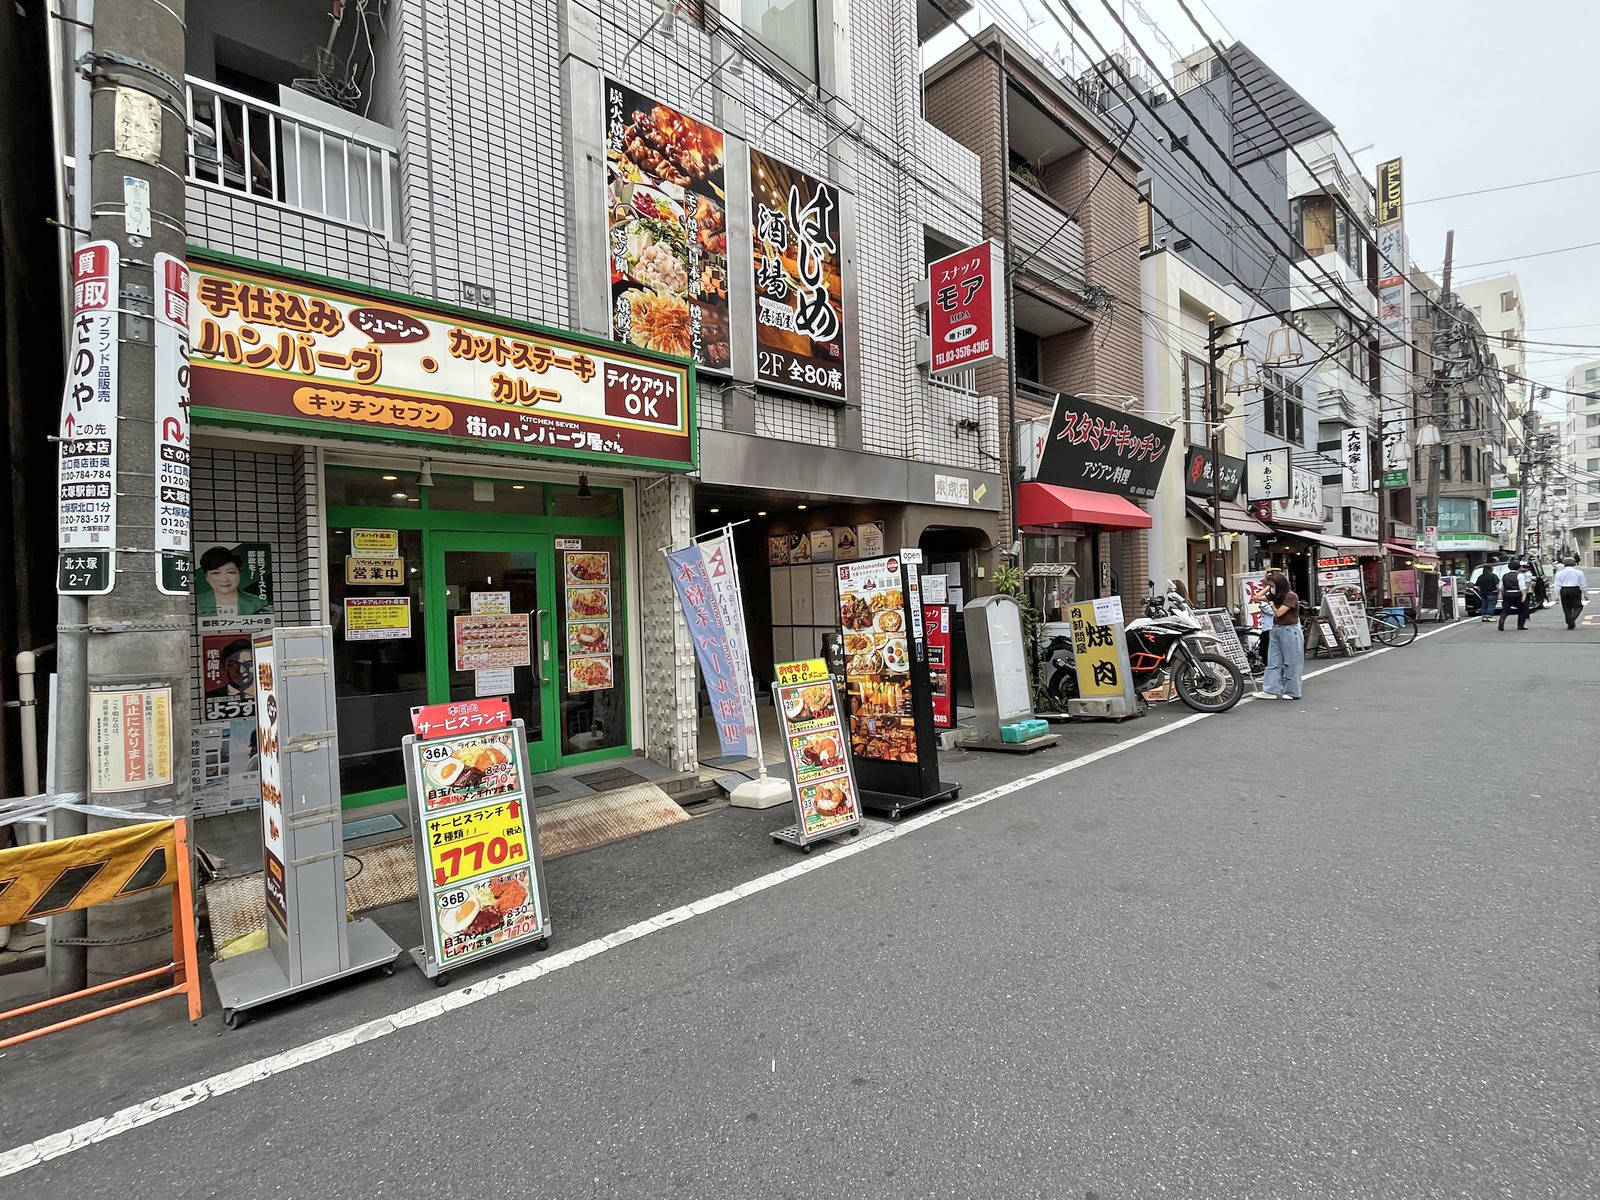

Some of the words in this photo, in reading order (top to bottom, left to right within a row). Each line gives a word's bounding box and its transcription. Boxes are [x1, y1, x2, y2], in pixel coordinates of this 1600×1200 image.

[609, 88, 625, 154] 炭火焼き
[1388, 160, 1401, 209] BLADE
[78, 251, 96, 276] 質
[614, 230, 629, 275] モツ鍋
[758, 203, 787, 299] 酒場
[788, 183, 839, 342] はじめ
[687, 250, 701, 296] 日本酒
[941, 258, 981, 283] スナック
[199, 276, 344, 337] 手仕込み
[936, 274, 984, 312] モア
[616, 297, 631, 344] 焼餃子
[689, 304, 704, 364] 焼きとん
[760, 308, 794, 331] 居酒屋
[72, 315, 96, 412] さのや
[98, 316, 112, 403] ブランド品販売
[199, 319, 382, 385] ハンバーグ
[447, 326, 596, 383] カットステーキ
[606, 369, 675, 399] テイクアウト
[759, 351, 785, 378] 2F
[788, 358, 843, 392] 全80席
[490, 371, 562, 406] カレー
[309, 394, 441, 424] キッチンセブン
[519, 415, 554, 427] KITCHEN
[555, 421, 580, 430] SEVEN
[624, 394, 660, 419] OK
[76, 424, 107, 436] この先
[466, 416, 624, 454] 街のハンバーグ屋さん
[1057, 410, 1166, 462] スタミナキッチン
[1347, 430, 1362, 464] 大塚家
[1081, 461, 1131, 486] アジアン料理
[61, 485, 109, 499] 大塚駅前店
[65, 557, 98, 570] 北大塚
[903, 550, 921, 562] open
[69, 574, 92, 586] 2-7
[352, 567, 399, 580] 営業中
[778, 663, 810, 676] おすすめ
[1086, 620, 1118, 687] 焼肉
[418, 710, 509, 735] サービスランチ
[447, 703, 479, 716] 本日の
[125, 694, 143, 781] 廃止になりました
[425, 746, 449, 761] 36A
[482, 773, 508, 788] 770
[430, 806, 505, 832] サービスランチ
[440, 837, 524, 878] 770円
[441, 891, 466, 908] 36B
[445, 937, 494, 960] ヒレカツ定食
